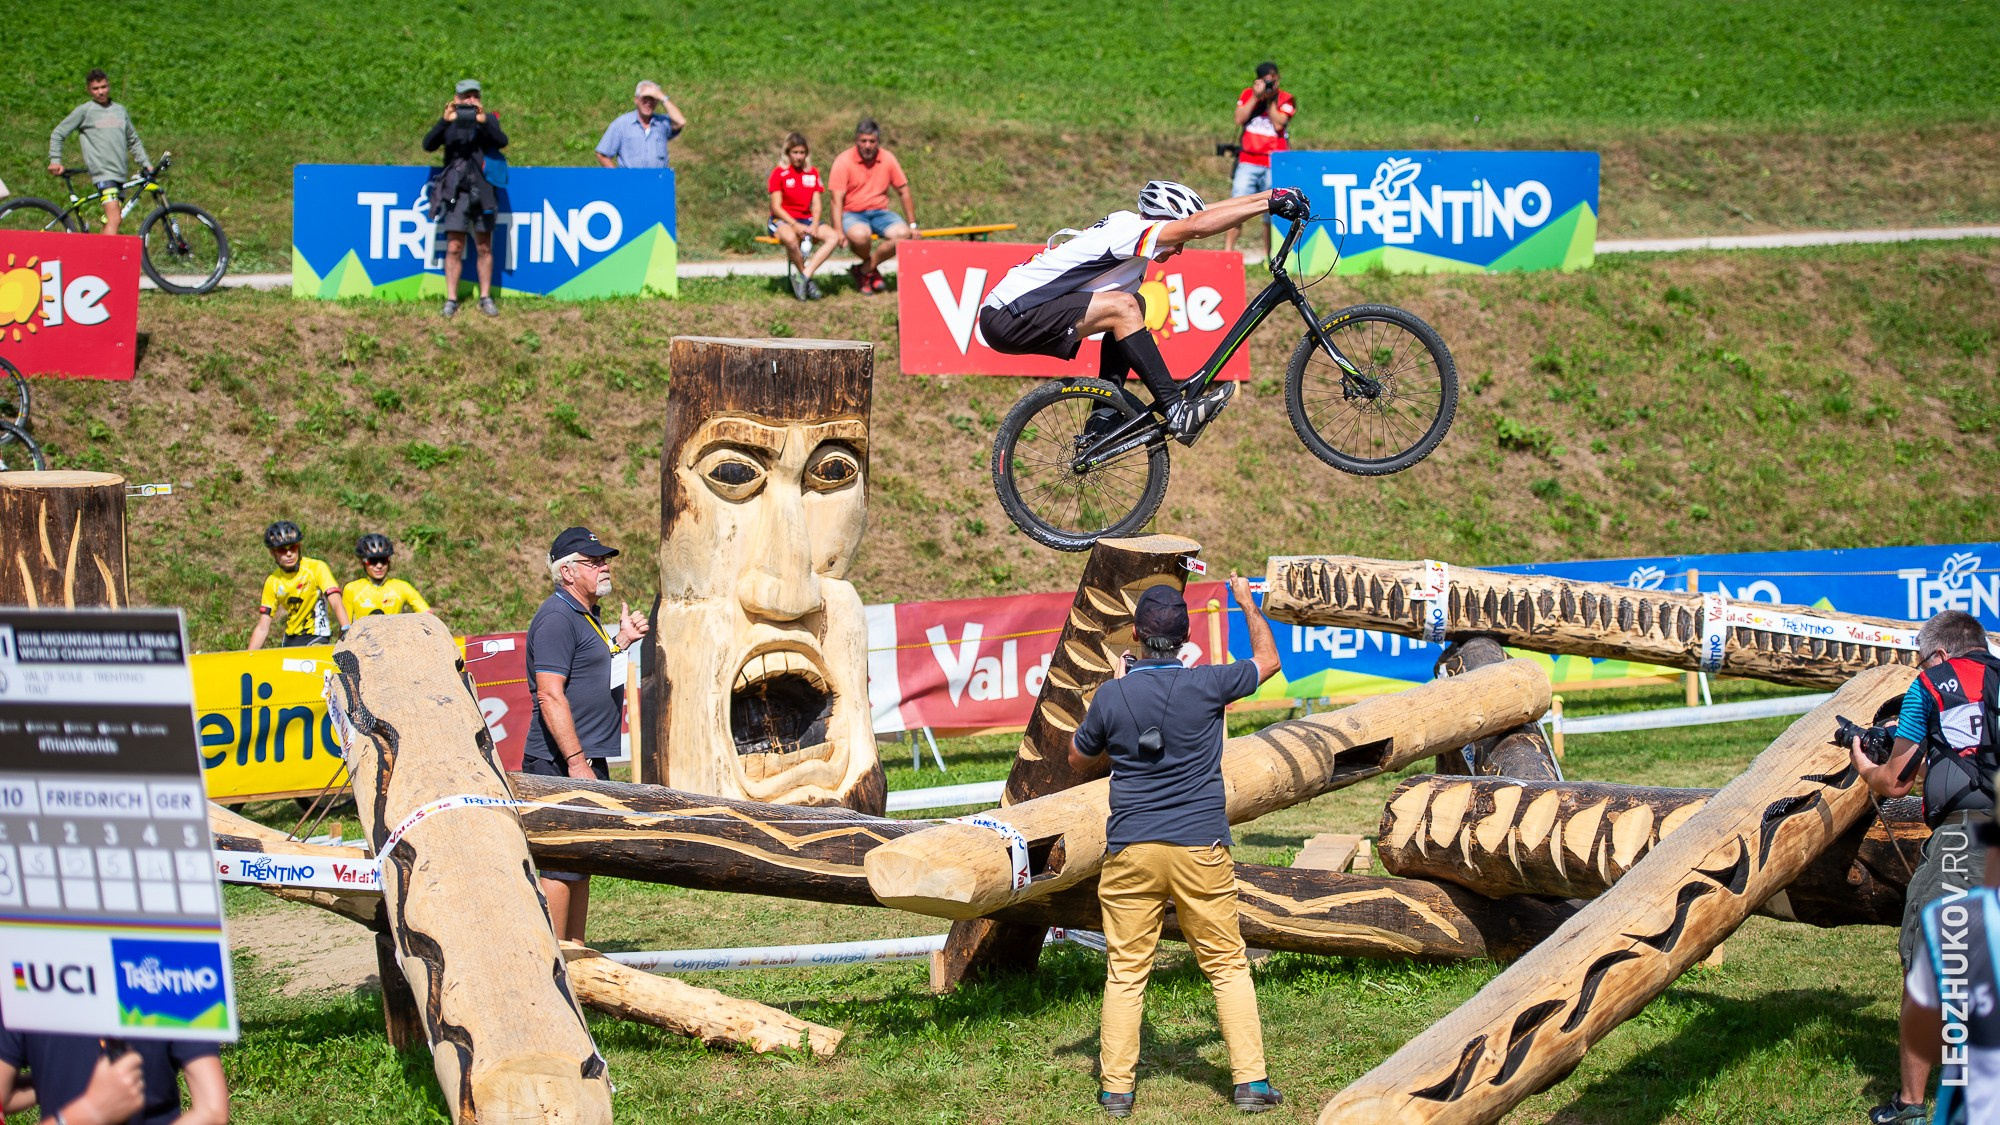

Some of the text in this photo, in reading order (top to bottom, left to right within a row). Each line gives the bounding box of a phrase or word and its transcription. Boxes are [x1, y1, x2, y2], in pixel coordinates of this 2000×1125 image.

[1322, 173, 1552, 245] TRENTINO
[357, 191, 623, 271] TRETINO
[1061, 386, 1113, 398] MAXXIS
[41, 633, 100, 646] MOUNTAIN
[101, 634, 129, 647] BIKE
[139, 633, 179, 649] TRIALS
[1781, 617, 1834, 636] TRENTINO
[1847, 625, 1864, 641] Val
[18, 647, 59, 660] WORLD
[61, 648, 154, 661] CHAMPIONSHIPS
[925, 621, 1019, 709] Val
[22, 671, 43, 682] VAL
[57, 672, 83, 683] SOLE
[93, 672, 145, 683] TRENTINO
[24, 683, 49, 695] ITALY
[38, 736, 119, 753] #TrialsWorlds
[46, 789, 142, 808] FRIEDRICH
[156, 794, 191, 809] GER
[28, 820, 39, 842] 1
[63, 821, 79, 844] 2
[103, 823, 119, 846] 3
[142, 824, 158, 847] 4
[183, 825, 198, 848] 5
[389, 814, 407, 844] Val
[240, 859, 315, 882] TRENTINO
[332, 863, 357, 883] Val
[359, 874, 370, 884] di
[28, 960, 218, 995] UCI TRENTINO
